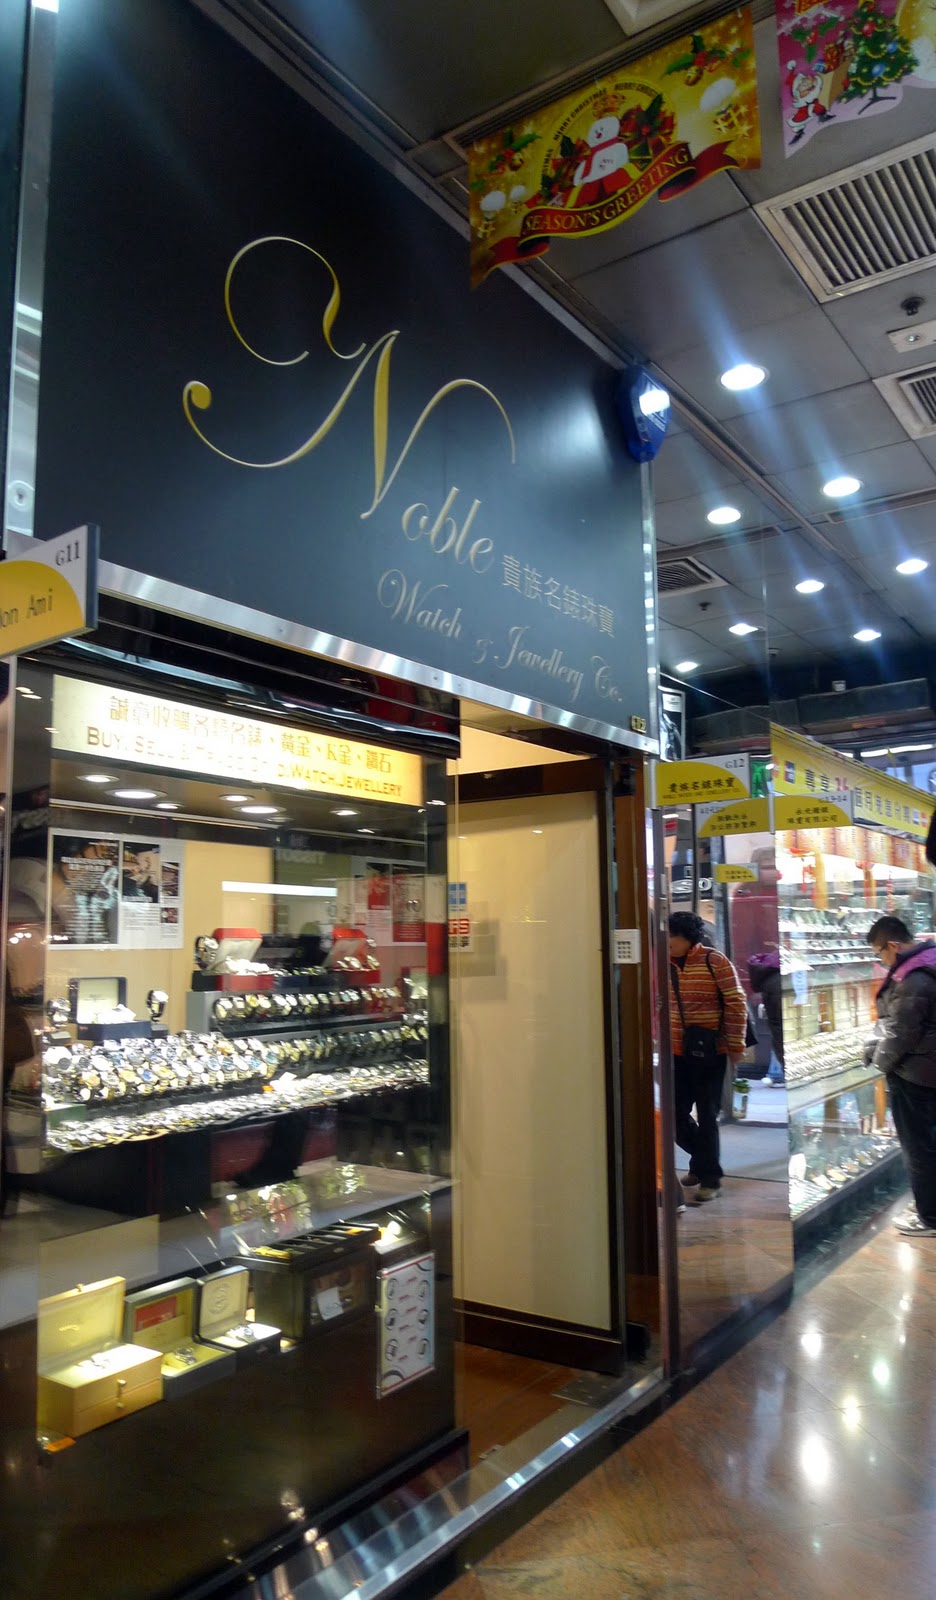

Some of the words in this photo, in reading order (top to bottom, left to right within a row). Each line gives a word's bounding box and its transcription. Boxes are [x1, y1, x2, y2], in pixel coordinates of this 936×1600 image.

[524, 210, 601, 232] SEASON'S
[602, 147, 690, 221] GREETING
[55, 540, 80, 567] G11
[0, 605, 19, 629] on
[26, 588, 54, 619] Ami
[377, 568, 463, 640] Watch
